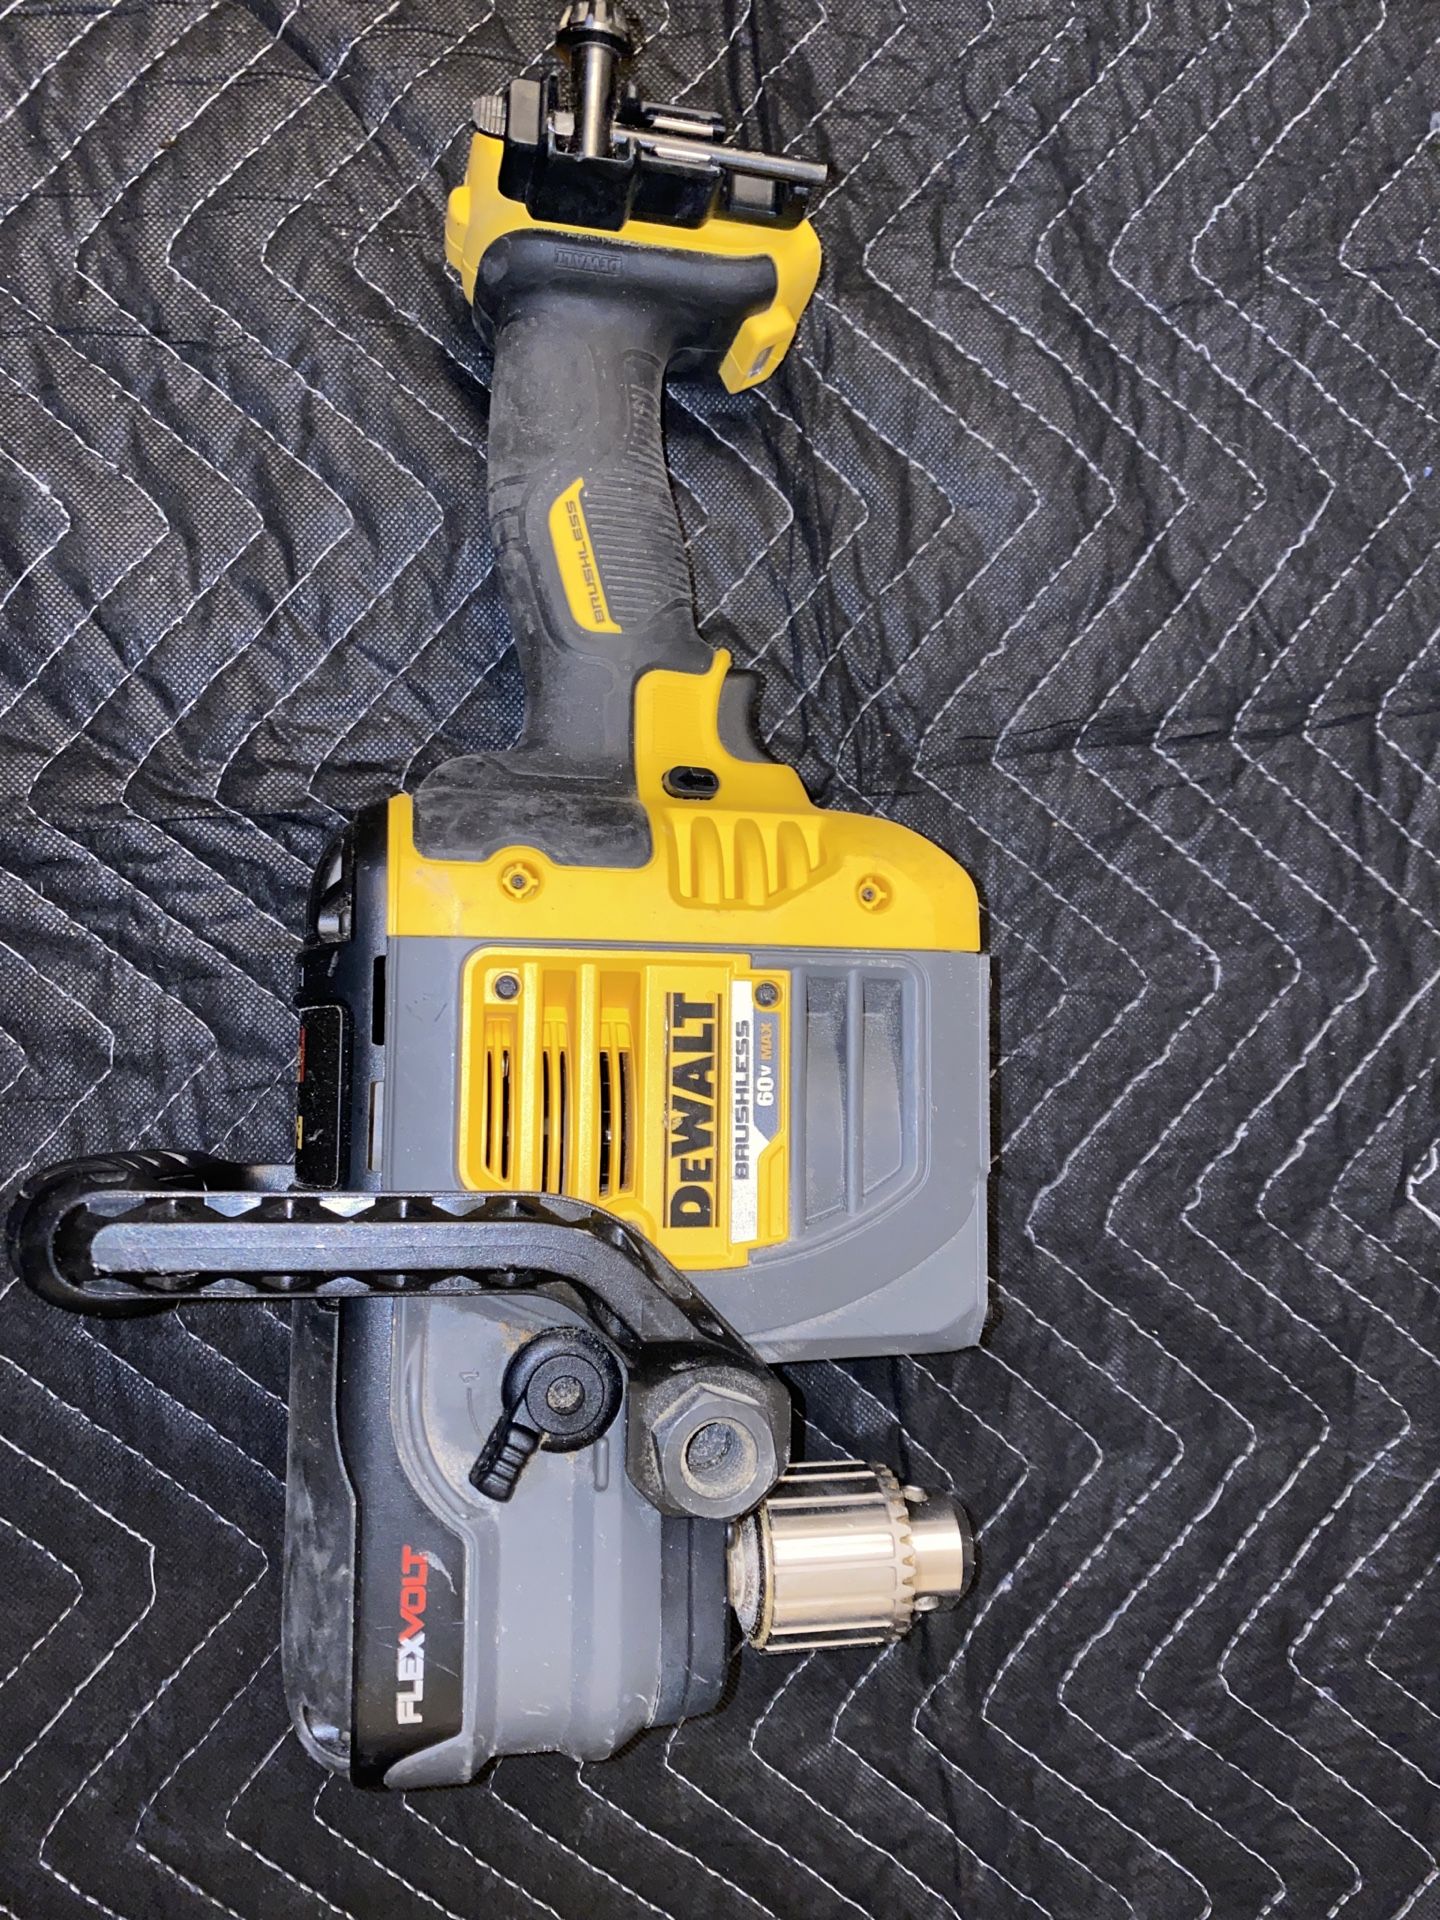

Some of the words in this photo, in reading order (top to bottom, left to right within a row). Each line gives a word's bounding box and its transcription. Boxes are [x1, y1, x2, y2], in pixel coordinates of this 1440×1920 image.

[555, 250, 622, 273] DEWALT
[565, 500, 606, 624] BRUSHLESS
[669, 992, 715, 1228] DEWALT
[734, 1020, 750, 1180] BRUSHLESS
[759, 1022, 773, 1060] MAX
[396, 1544, 429, 1724] FLEXVOLT
